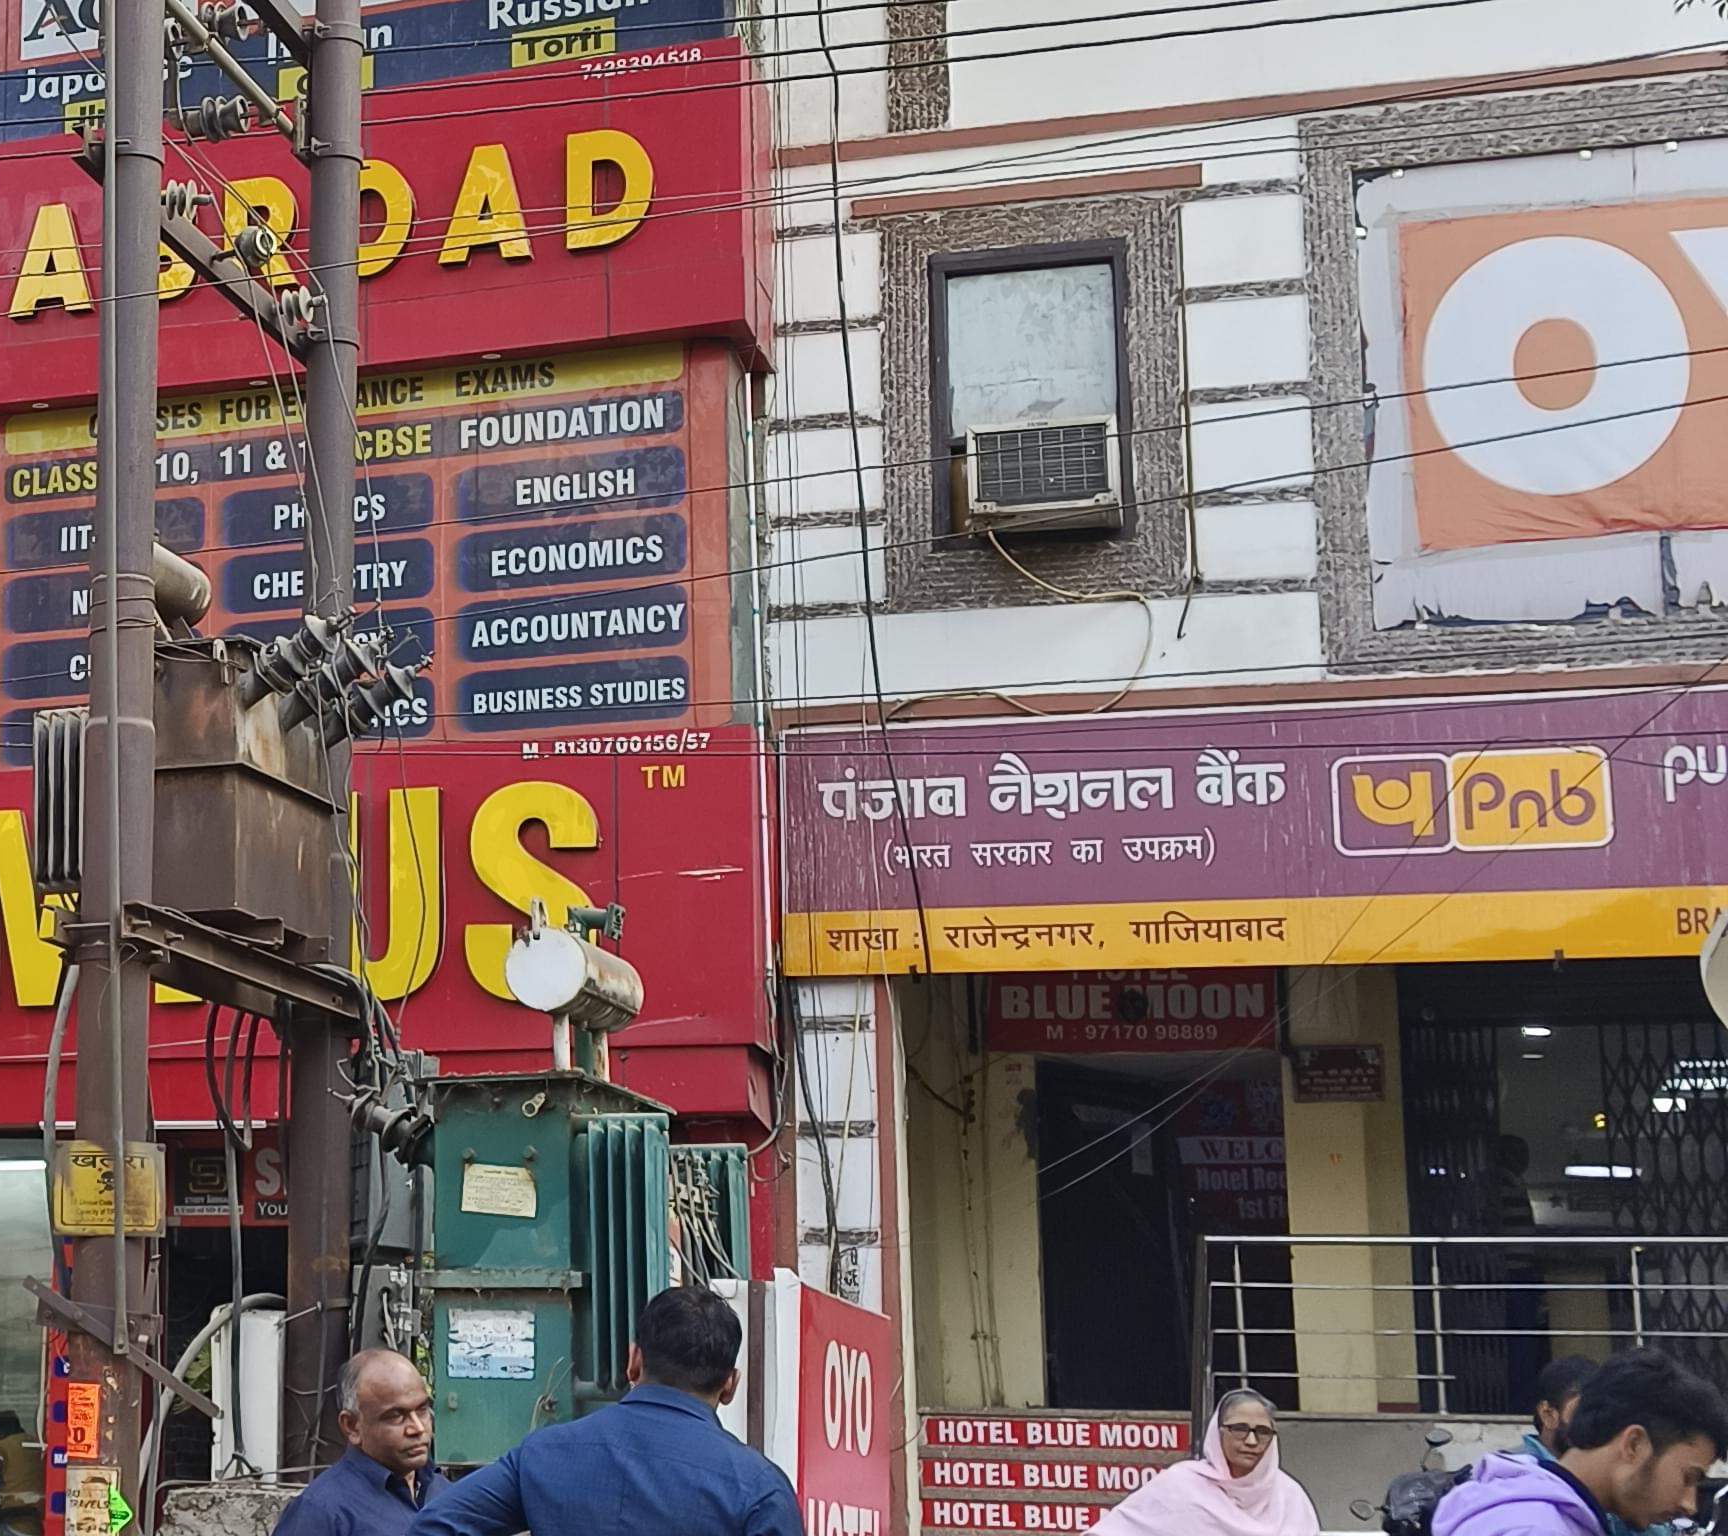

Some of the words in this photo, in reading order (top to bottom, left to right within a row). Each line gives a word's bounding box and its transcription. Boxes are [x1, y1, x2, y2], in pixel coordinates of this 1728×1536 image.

[7, 128, 656, 320] AROAD
[218, 394, 272, 426] FOR
[455, 361, 556, 398] EXAMS
[220, 444, 252, 475] 11
[265, 440, 287, 470] &
[460, 398, 666, 451] FOUNDATION
[515, 468, 636, 506] ENGLISH
[490, 534, 664, 578] ECONOMICS
[471, 602, 687, 649] ACCOUNTANCY
[472, 684, 583, 716] BUSINESS
[589, 677, 687, 707] STUDIES
[641, 764, 687, 790] TM
[818, 767, 968, 822] पंजाब
[1195, 744, 1288, 809] बैंक
[970, 840, 1052, 868] सरकार
[1071, 839, 1104, 864] का
[1000, 984, 1113, 1021] BLUE
[823, 1339, 874, 1457] OYO
[938, 1420, 1019, 1445] HOTEL
[1027, 1422, 1091, 1447] BLUE
[1099, 1423, 1178, 1449] MOON
[934, 1462, 1016, 1487] HOTEL
[1023, 1464, 1089, 1490] BLUE
[933, 1502, 1017, 1529] HOTEL
[1023, 1504, 1090, 1531] BLUE
